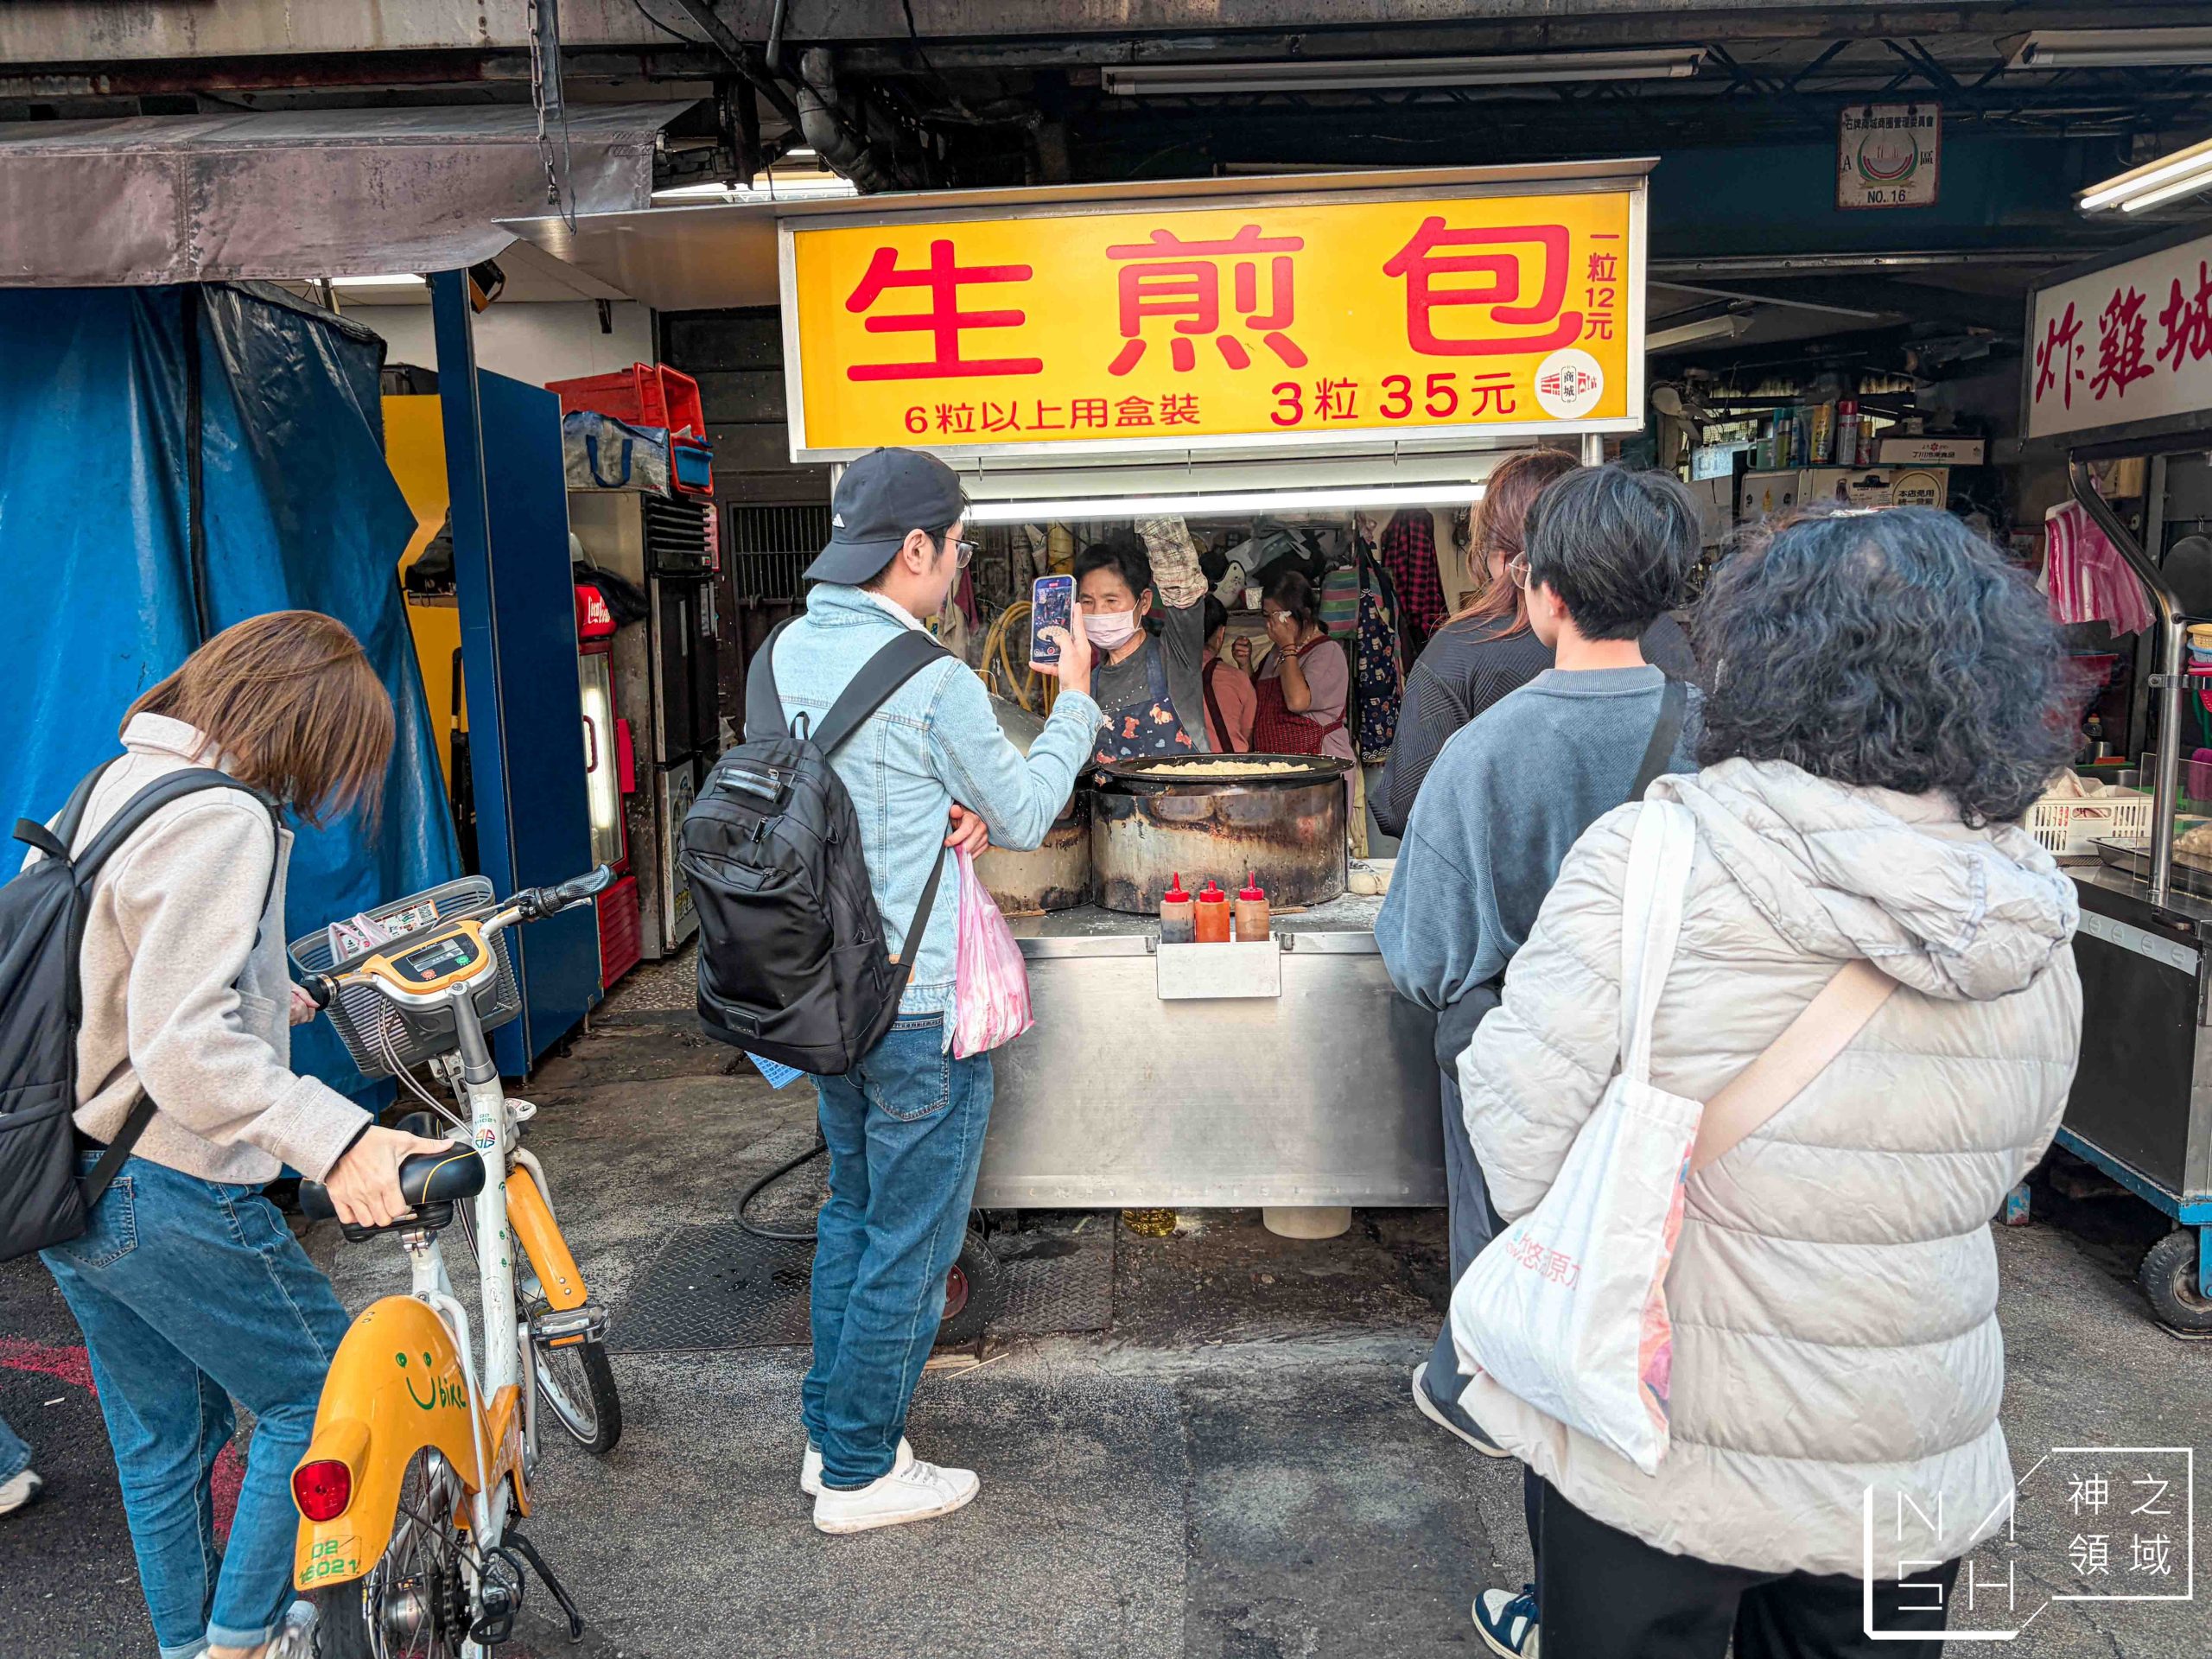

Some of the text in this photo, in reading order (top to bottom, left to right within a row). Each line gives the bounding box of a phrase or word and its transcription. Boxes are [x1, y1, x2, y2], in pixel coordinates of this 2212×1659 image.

[1842, 156, 1852, 171] A
[845, 216, 1583, 382] 生煎包
[1585, 233, 1620, 340] 一粒12元
[906, 393, 1200, 435] 6粒以上用盒裝
